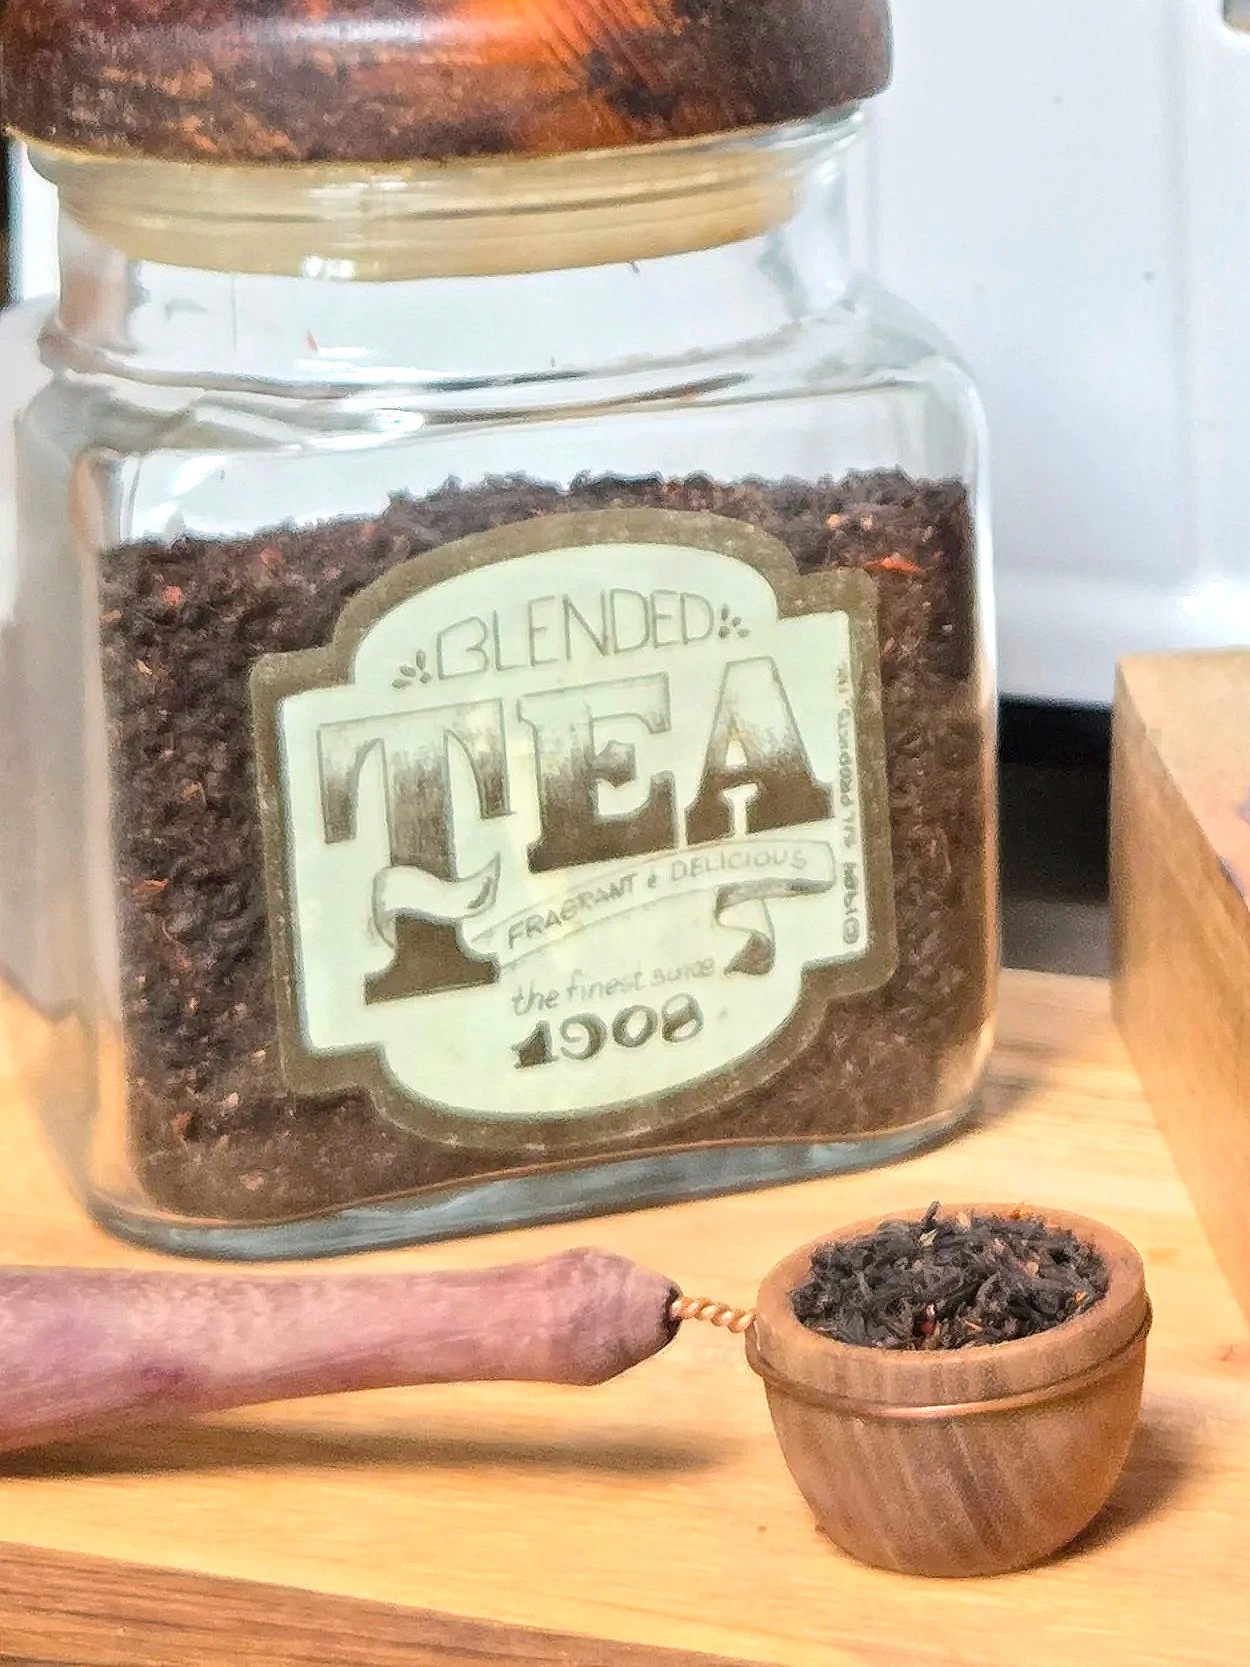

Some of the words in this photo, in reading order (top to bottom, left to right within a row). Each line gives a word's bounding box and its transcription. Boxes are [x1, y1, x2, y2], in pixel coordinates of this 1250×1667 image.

[436, 587, 715, 680] BLENDED
[316, 656, 834, 1006] TEA
[508, 872, 638, 949] FRAGRANT
[671, 847, 810, 880] DELICIOUS
[511, 979, 560, 1016] the
[566, 969, 648, 1003] finest
[512, 993, 705, 1069] 1908
